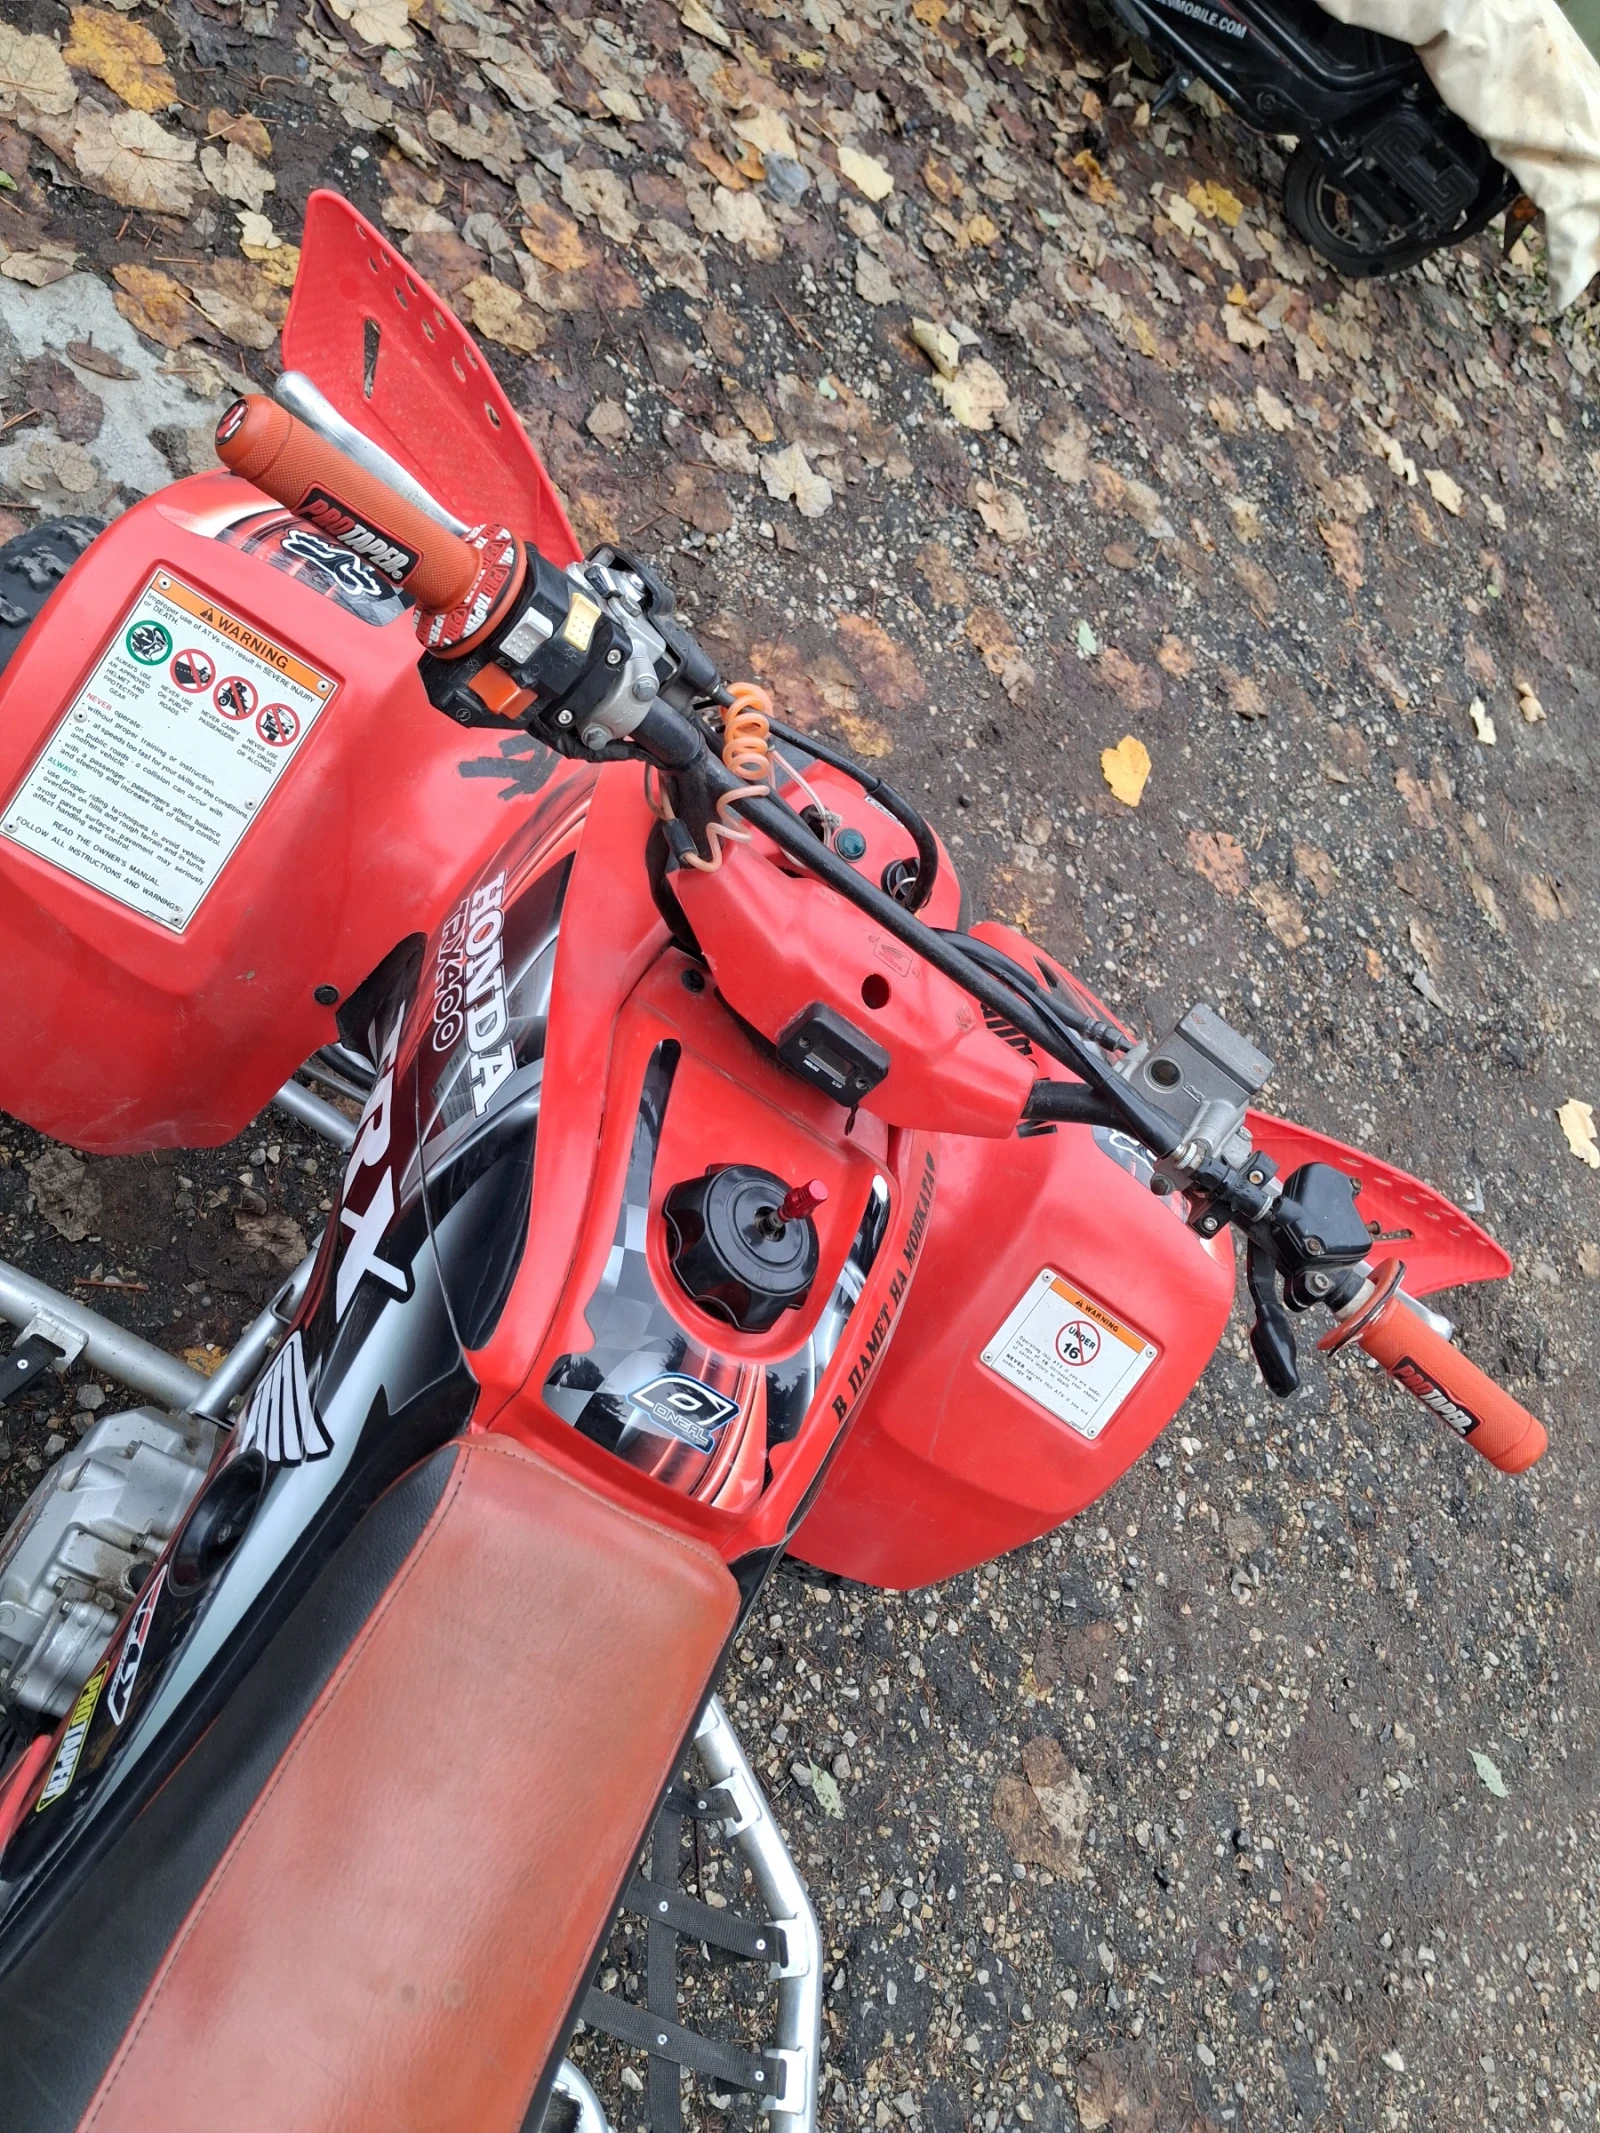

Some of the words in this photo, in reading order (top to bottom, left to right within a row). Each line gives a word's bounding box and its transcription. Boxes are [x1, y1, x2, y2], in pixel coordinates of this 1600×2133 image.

[152, 604, 178, 626] DEATH.
[147, 592, 179, 616] Improper
[179, 614, 193, 625] use
[220, 641, 235, 652] can
[234, 650, 255, 665] result
[254, 661, 262, 670] in
[262, 666, 290, 688] SEVERE
[290, 684, 315, 703] INJURY
[218, 615, 288, 670] WARNING
[103, 674, 140, 700] PROTECTIVE
[106, 668, 130, 685] HELMET
[131, 684, 145, 694] AND
[107, 660, 118, 669] AN
[118, 667, 150, 689] APPROVED
[114, 656, 138, 673] ALWAYS
[139, 670, 152, 681] USE
[86, 692, 112, 711] NEVER
[113, 710, 143, 730] operate:
[109, 687, 126, 700] GEAR
[157, 690, 167, 699] ON
[167, 697, 189, 713] PUBLIC
[158, 700, 179, 716] ROADS
[160, 684, 180, 699] NEVER
[180, 696, 194, 707] USE
[198, 716, 235, 742] PASSENGERS
[200, 709, 220, 724] NEVER
[220, 721, 240, 736] CARRY
[70, 732, 98, 750] another
[99, 749, 125, 768] vehicle.
[87, 705, 114, 724] without
[114, 722, 138, 739] proper
[140, 737, 167, 758] training
[178, 760, 215, 787] instruction.
[236, 748, 246, 757] OR
[246, 755, 272, 774] ALCOHOL
[241, 743, 256, 755] WITH
[256, 752, 276, 768] DRUGS
[246, 738, 266, 752] NEVER
[266, 750, 278, 760] USE
[74, 725, 84, 734] on
[85, 732, 108, 748] public
[109, 746, 130, 762] roads
[142, 766, 171, 786] collision
[172, 784, 186, 795] can
[186, 793, 207, 807] occur
[208, 806, 223, 818] with
[92, 722, 101, 730] at
[100, 727, 126, 745] speeds
[125, 741, 138, 752] too
[137, 748, 152, 760] fast
[151, 756, 162, 766] for
[160, 764, 178, 776] your
[176, 773, 195, 787] skills
[202, 788, 214, 799] the
[214, 796, 248, 820] conditions.
[59, 748, 75, 760] and
[75, 757, 104, 778] steering
[105, 775, 120, 786] and
[120, 782, 150, 804] increase
[150, 802, 164, 813] risk
[174, 815, 195, 832] losing
[195, 829, 220, 846] control.
[64, 742, 79, 754] with
[88, 757, 126, 781] passenger
[130, 782, 170, 808] passengers
[172, 806, 193, 821] affect
[193, 818, 221, 838] balance
[32, 792, 55, 807] affect
[55, 803, 86, 826] handling
[87, 824, 103, 835] and
[104, 833, 130, 851] control.
[36, 785, 57, 800] avoid
[58, 799, 83, 814] paved
[84, 813, 116, 834] surfaces
[118, 833, 154, 856] pavement
[156, 854, 172, 867] may
[174, 865, 204, 886] seriously
[42, 776, 76, 798] overturns
[77, 796, 87, 804] on
[88, 801, 103, 814] hills
[103, 811, 119, 822] and
[118, 820, 139, 835] rough
[140, 831, 163, 848] terrain
[163, 846, 178, 857] and
[177, 853, 185, 862] in
[186, 858, 204, 873] turns.
[46, 769, 60, 780] use
[61, 778, 87, 794] proper
[88, 793, 109, 809] riding
[110, 805, 149, 832] techniques
[151, 829, 159, 837] to
[160, 836, 181, 852] avoid
[181, 848, 206, 865] vehicle
[15, 815, 49, 837] FOLLOW
[50, 836, 64, 848] ALL
[67, 845, 122, 879] INSTRUCTIONS
[122, 877, 140, 889] AND
[52, 820, 74, 836] READ
[76, 833, 92, 847] THE
[92, 844, 127, 867] OWNER'S
[431, 899, 469, 1052] TRX400
[469, 868, 516, 1118] HONDA
[1085, 1305, 1118, 1331] WARNING
[830, 1394, 848, 1423] В
[846, 1301, 896, 1396] ПАМЕТ
[887, 1269, 910, 1307] НА
[1063, 1343, 1082, 1359] 16
[1068, 1326, 1095, 1349] UNDER
[1005, 1352, 1025, 1369] NEVER
[651, 1402, 708, 1442] ONEAL
[40, 1673, 102, 1802] PROTAPER
